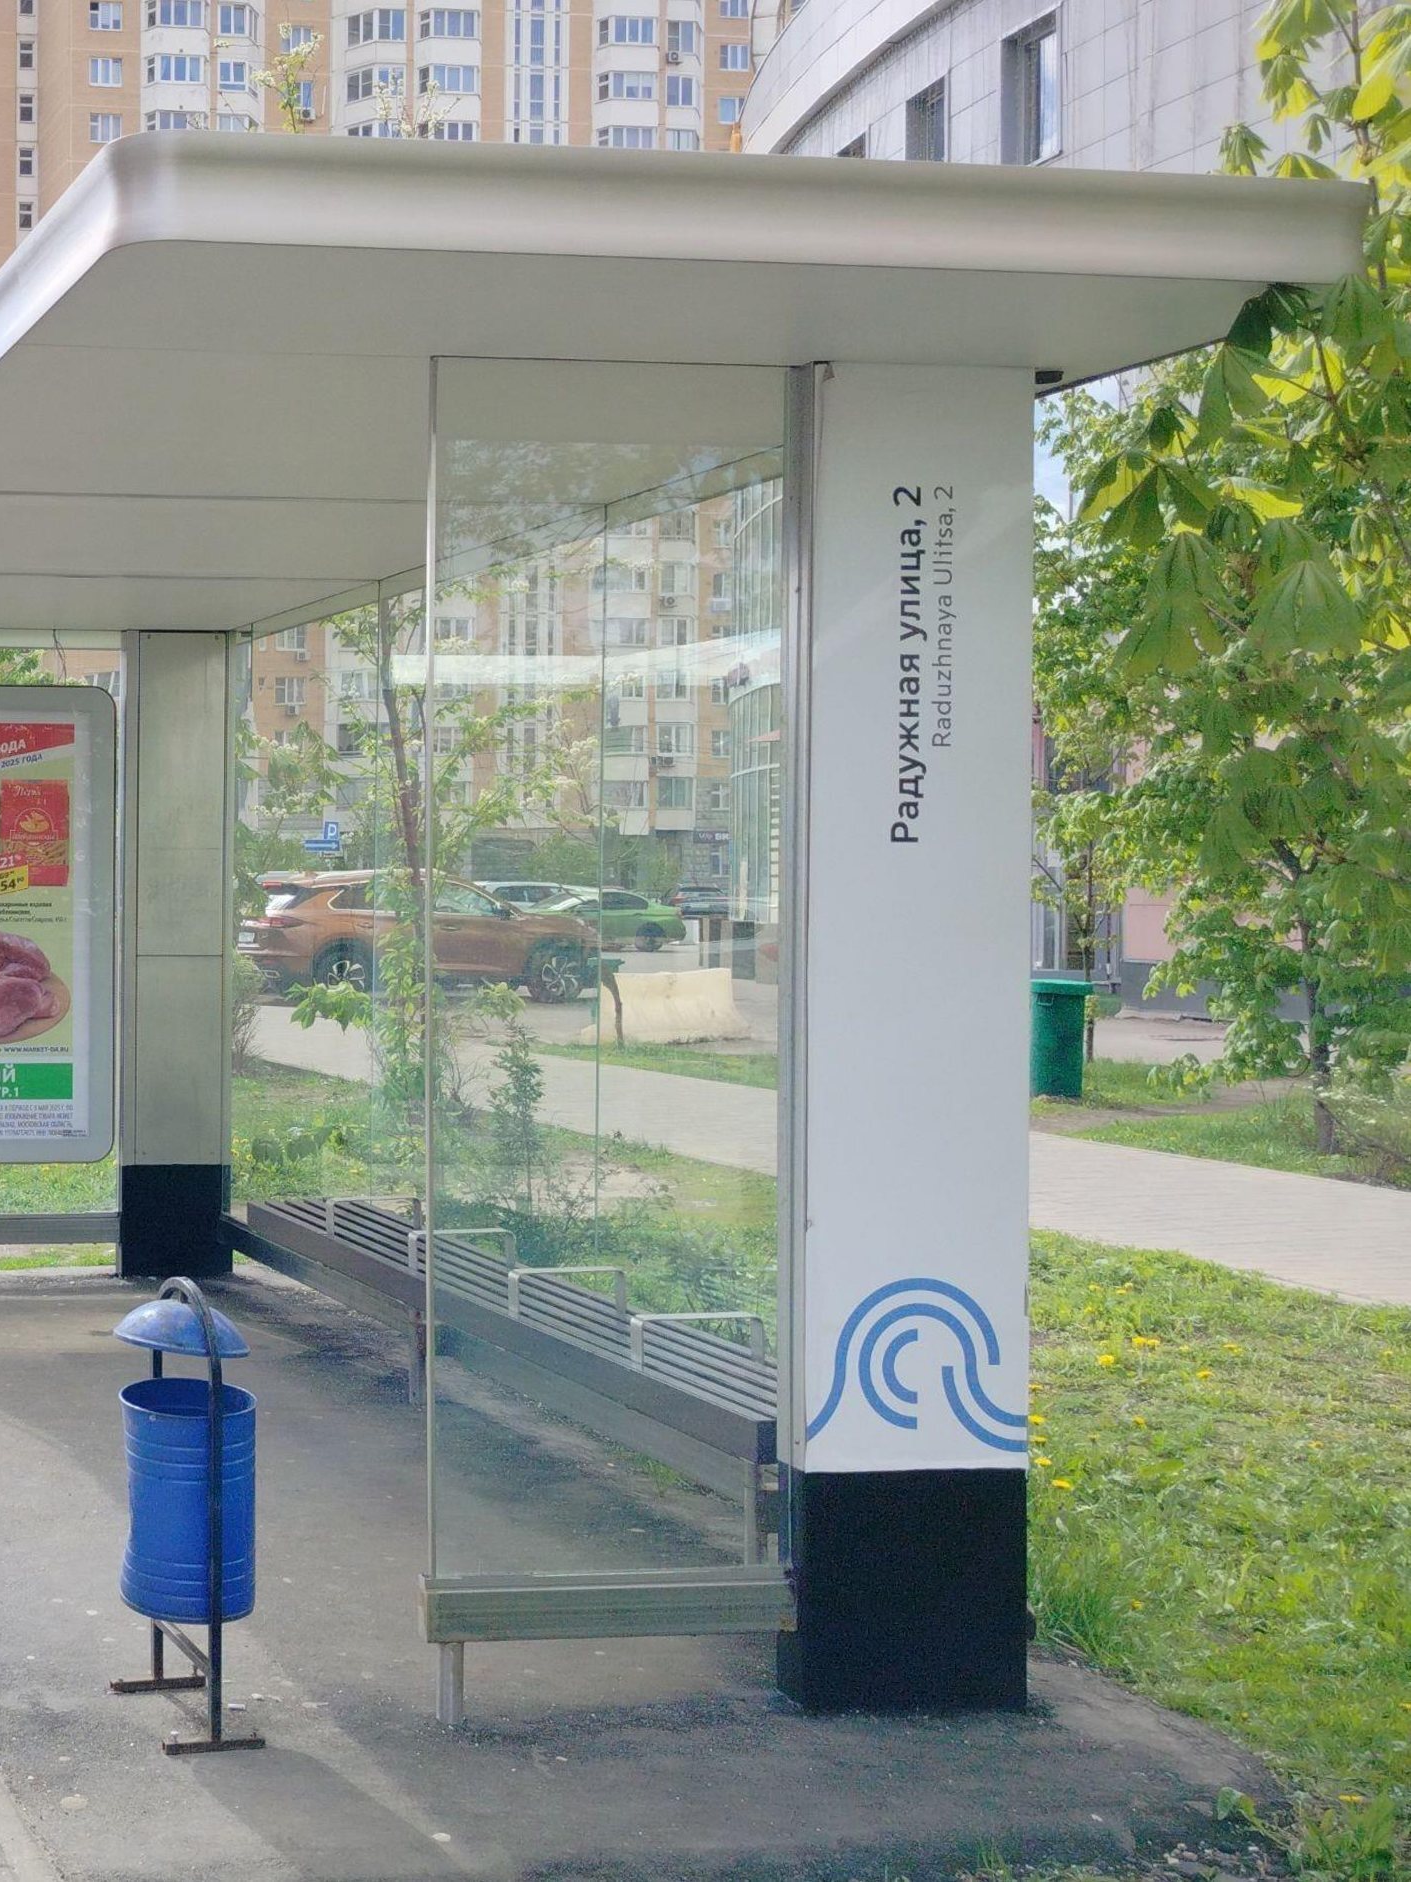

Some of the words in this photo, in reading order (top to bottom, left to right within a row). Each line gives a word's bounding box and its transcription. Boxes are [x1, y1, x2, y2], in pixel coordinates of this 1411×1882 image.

[893, 485, 922, 507] 2
[934, 485, 953, 500] 2
[899, 518, 928, 642] улица,
[933, 507, 957, 585] Ulitsa,
[931, 594, 957, 748] Raduzhnaya
[1, 758, 20, 769] 2025
[21, 754, 43, 765] ГОДА
[890, 653, 926, 843] Радужная
